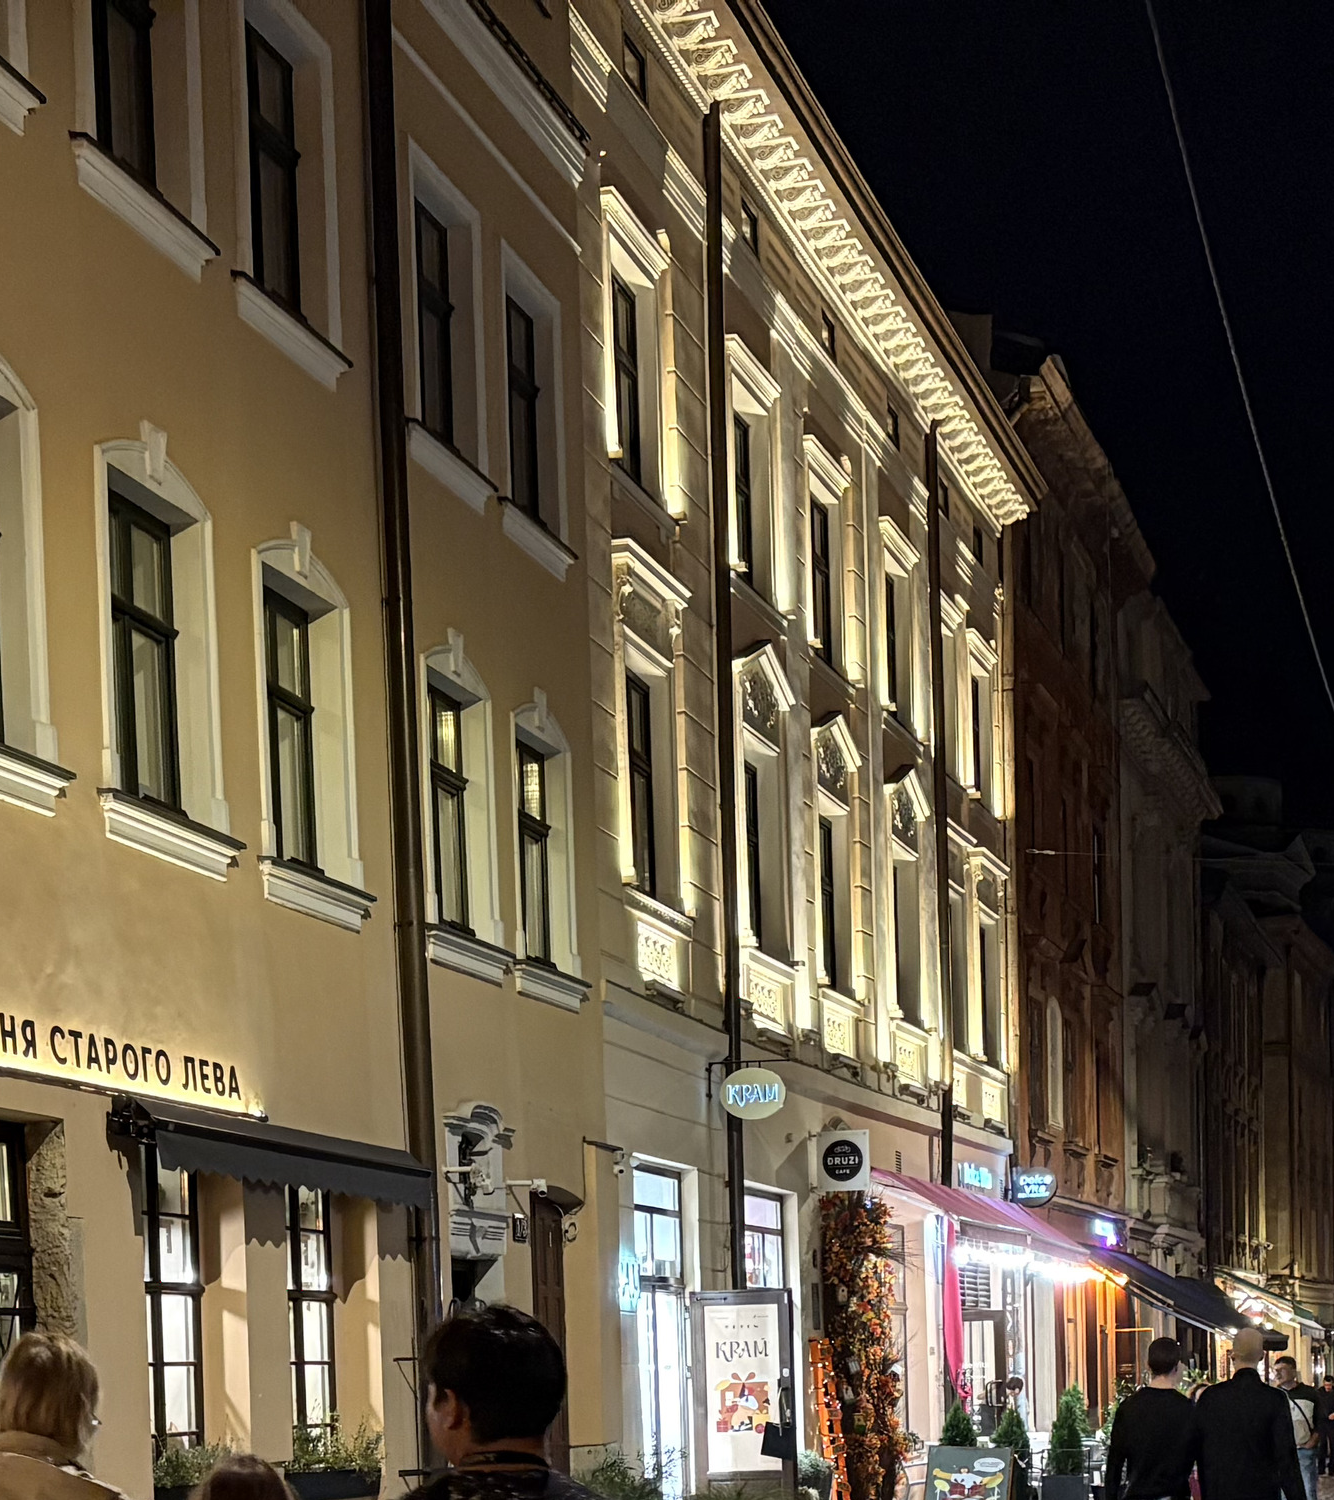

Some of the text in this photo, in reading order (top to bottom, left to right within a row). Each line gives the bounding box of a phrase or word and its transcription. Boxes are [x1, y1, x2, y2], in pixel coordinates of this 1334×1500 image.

[49, 1024, 171, 1086] СТАРОГО
[182, 1054, 242, 1100] ЛЕВА
[726, 1083, 779, 1108] KRAM
[827, 1155, 859, 1166] DRUZI
